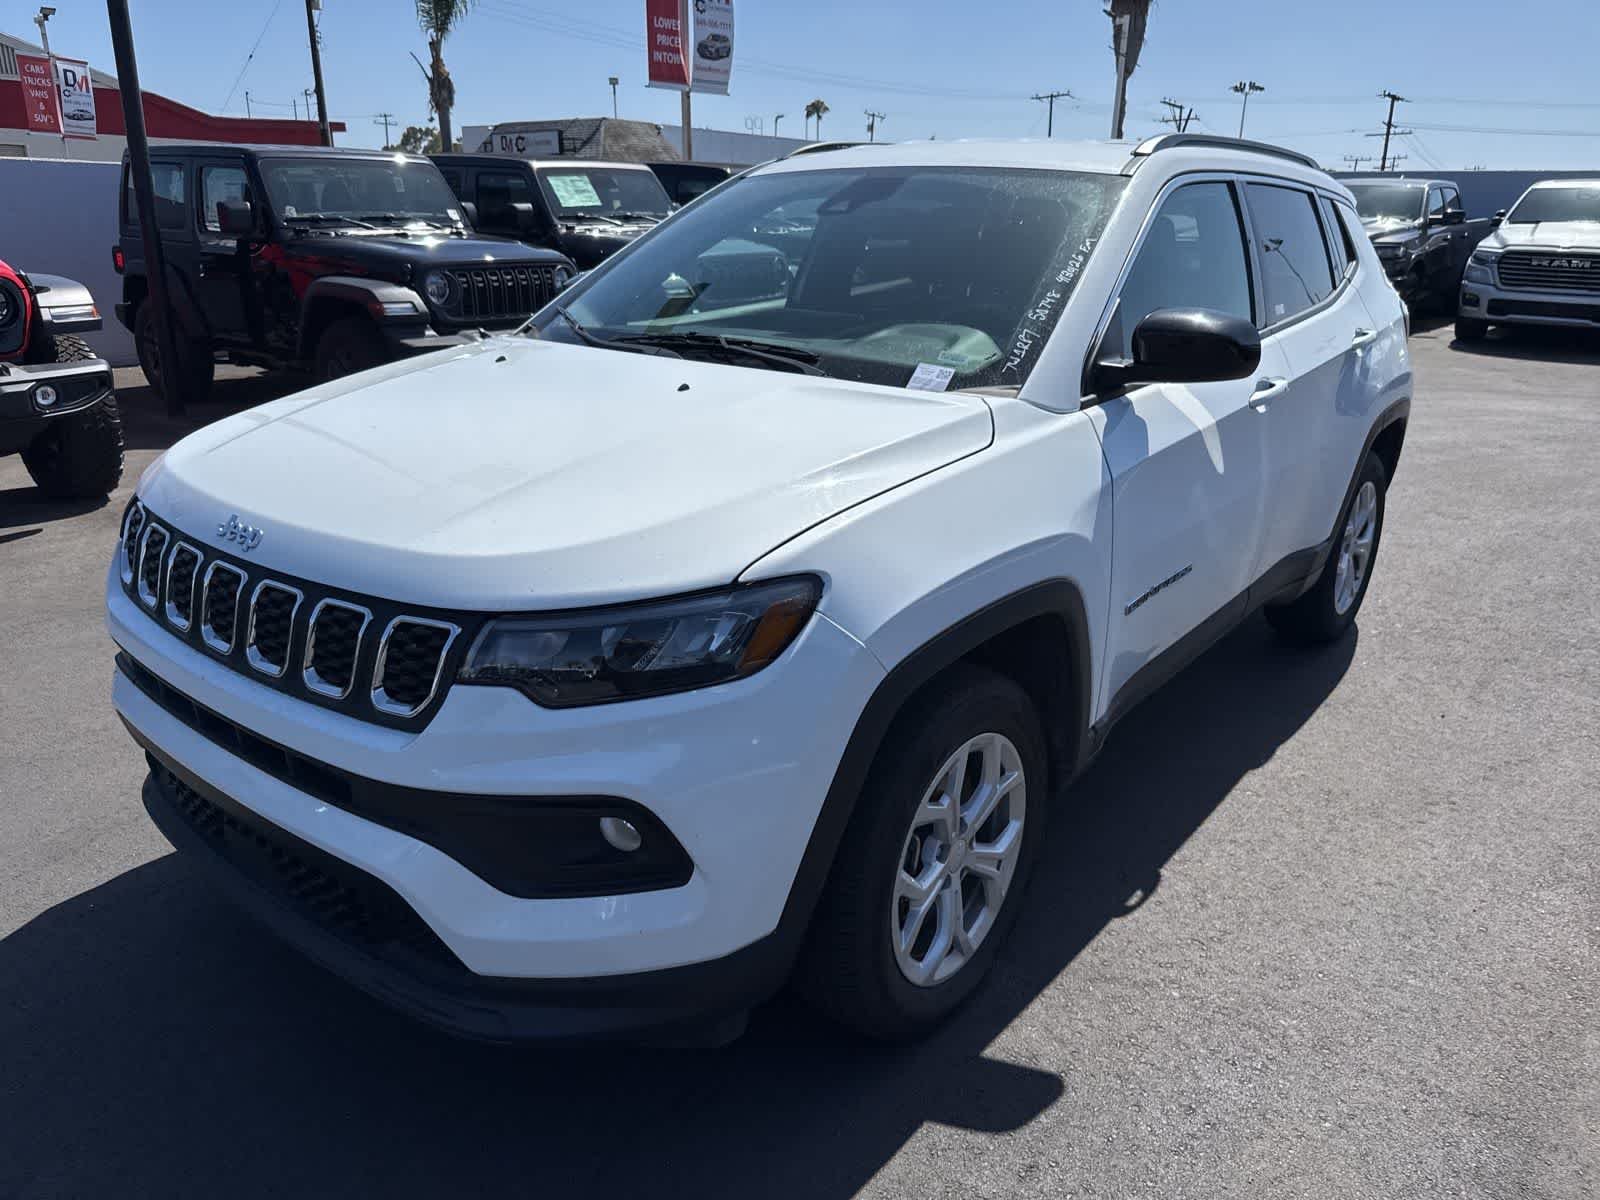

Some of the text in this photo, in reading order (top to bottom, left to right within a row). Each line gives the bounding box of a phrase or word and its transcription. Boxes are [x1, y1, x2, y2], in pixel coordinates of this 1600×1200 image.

[24, 63, 45, 74] CARS
[23, 76, 51, 87] TRUCKS
[29, 89, 49, 99] VANS
[39, 101, 46, 111] &
[1531, 257, 1592, 269] RAM
[216, 513, 264, 553] Jeep
